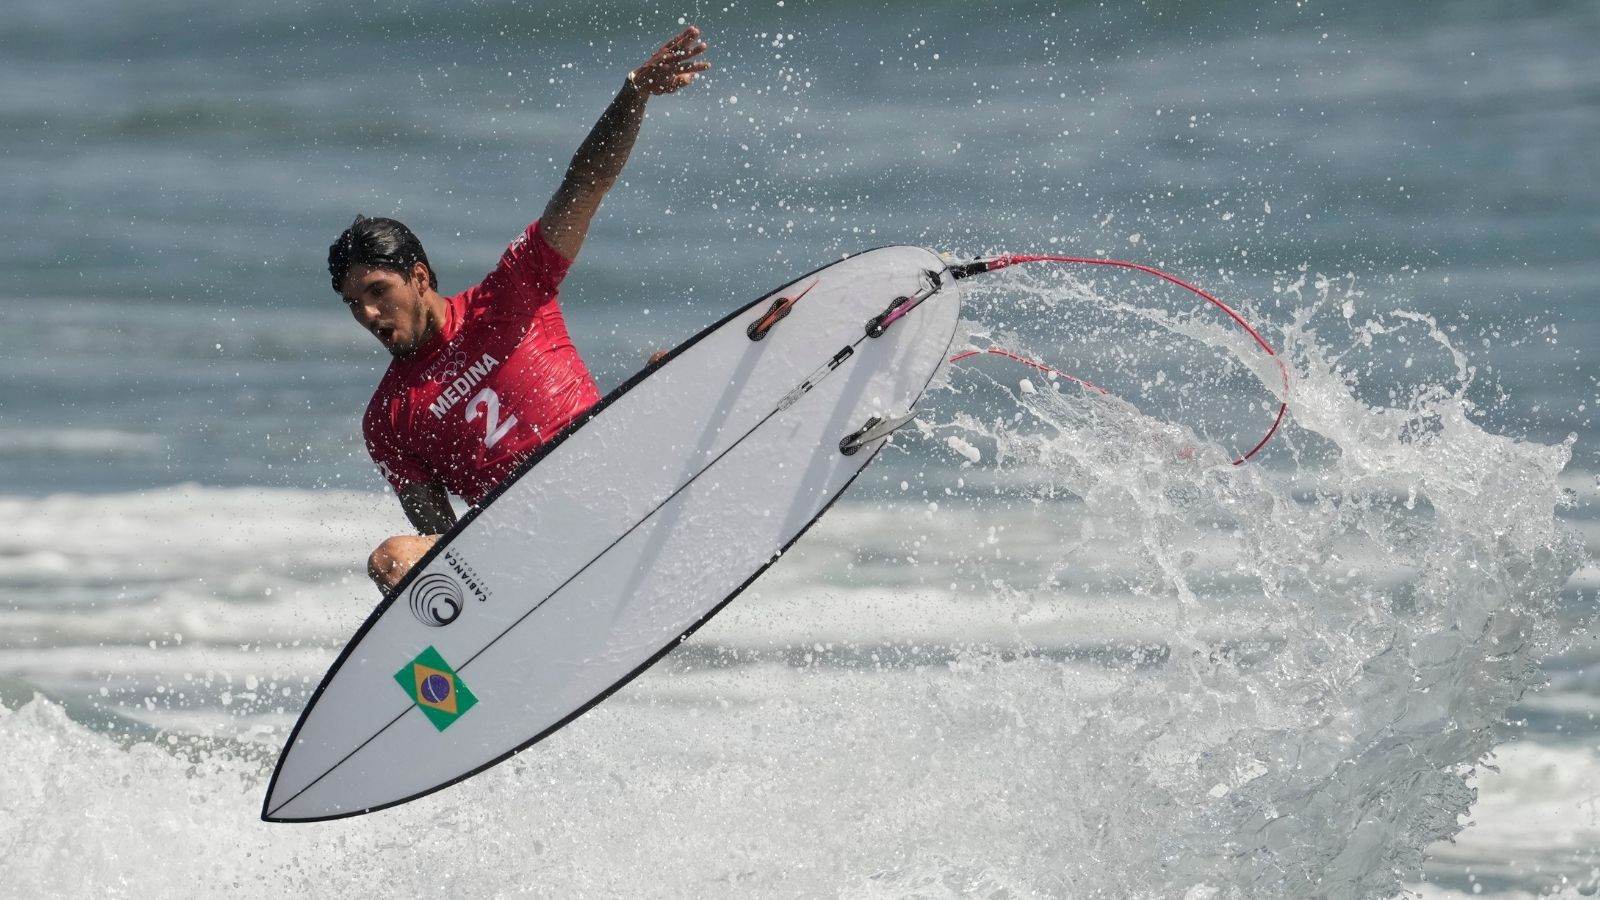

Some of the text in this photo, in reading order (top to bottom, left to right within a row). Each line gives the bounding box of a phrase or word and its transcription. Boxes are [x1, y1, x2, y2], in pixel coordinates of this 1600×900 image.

[428, 353, 500, 420] MEDINA
[465, 387, 519, 449] 2
[444, 551, 487, 602] CABIANCA
